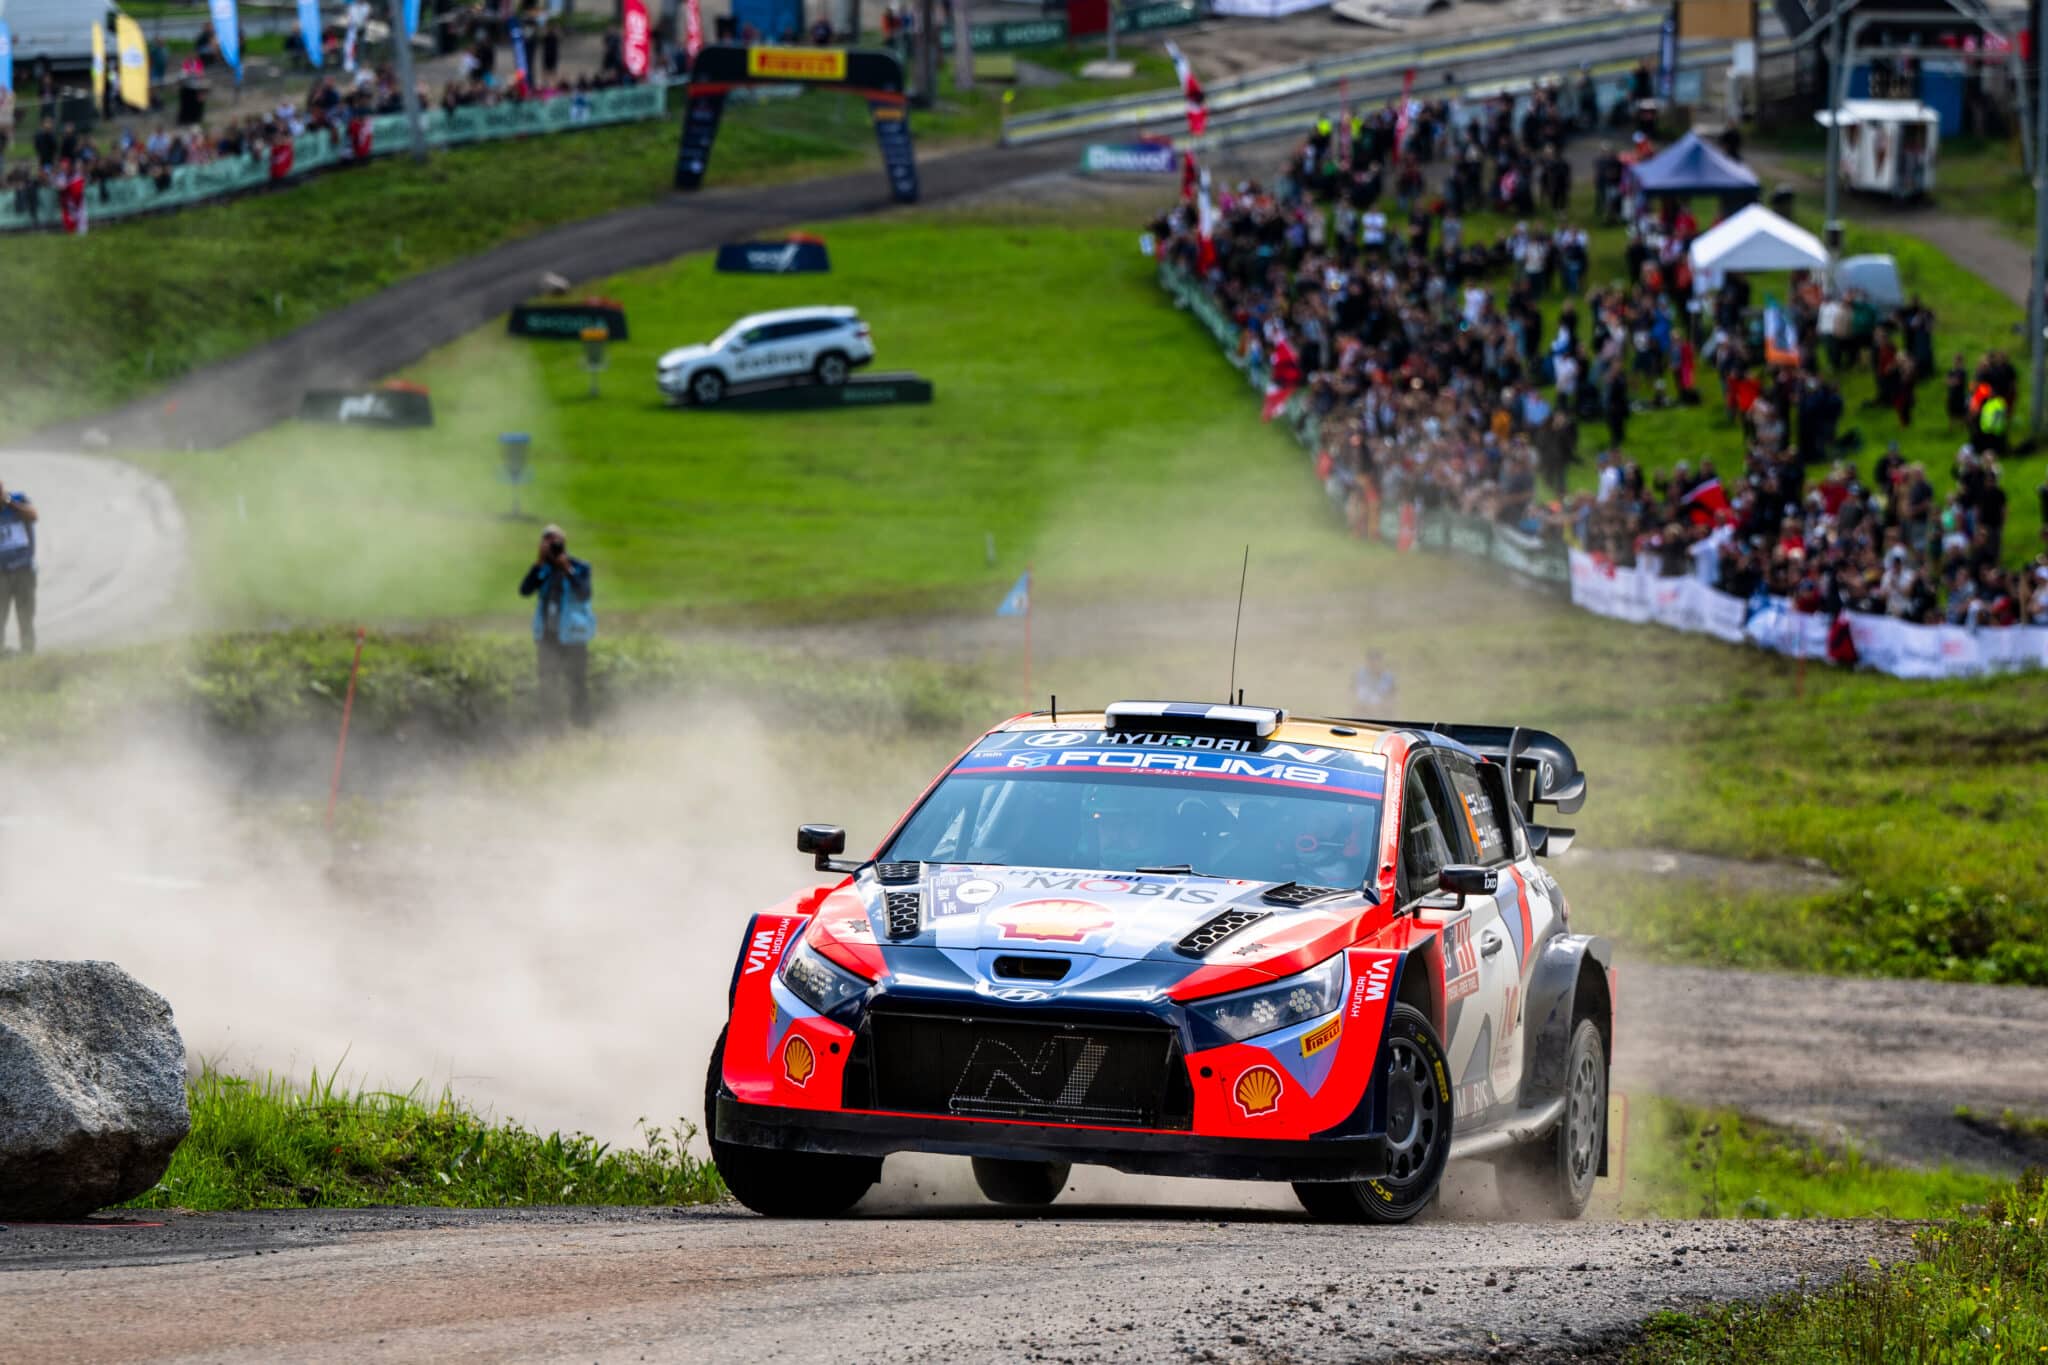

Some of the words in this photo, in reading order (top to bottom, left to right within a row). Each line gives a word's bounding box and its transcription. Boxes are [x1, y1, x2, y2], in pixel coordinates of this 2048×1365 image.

[1056, 750, 1330, 784] FORUM8
[1022, 876, 1219, 905] MOBIS
[771, 918, 792, 955] HYUNDAI
[1350, 975, 1367, 1018] HYUNDAI
[1305, 1018, 1341, 1052] PIRELLI
